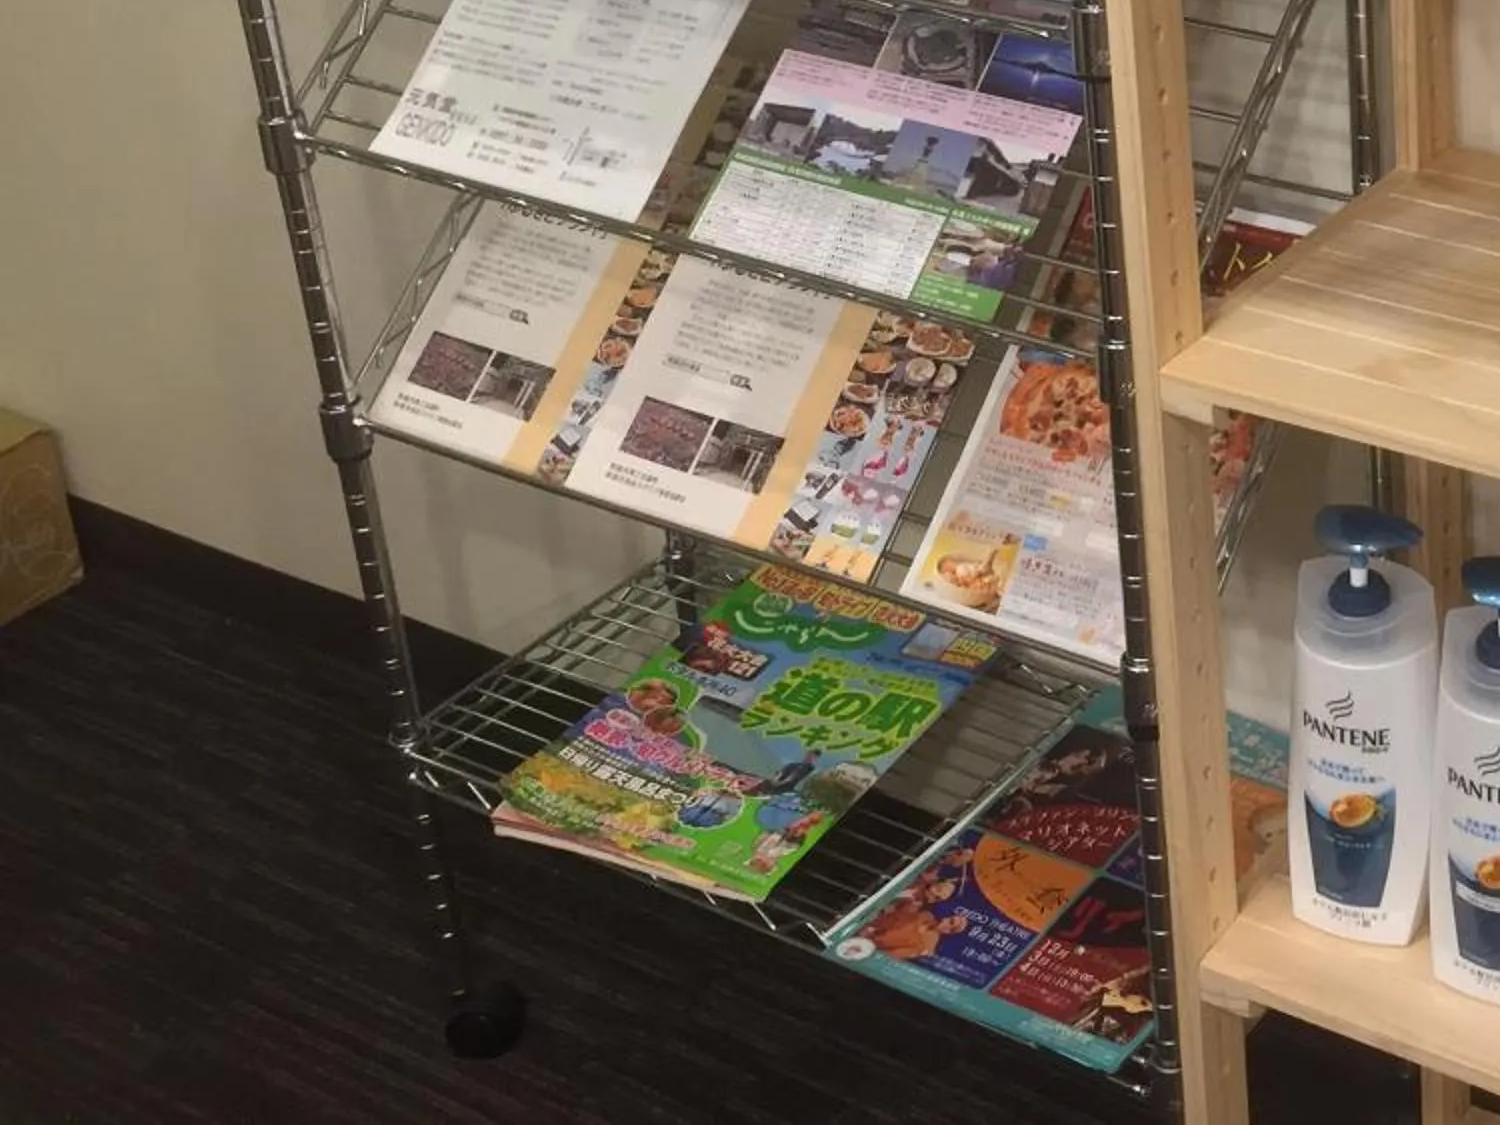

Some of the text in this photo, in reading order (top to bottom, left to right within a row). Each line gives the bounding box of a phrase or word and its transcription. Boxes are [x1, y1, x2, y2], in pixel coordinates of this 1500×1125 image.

[772, 673, 941, 739] 道の駅
[1302, 709, 1391, 747] PANTENE
